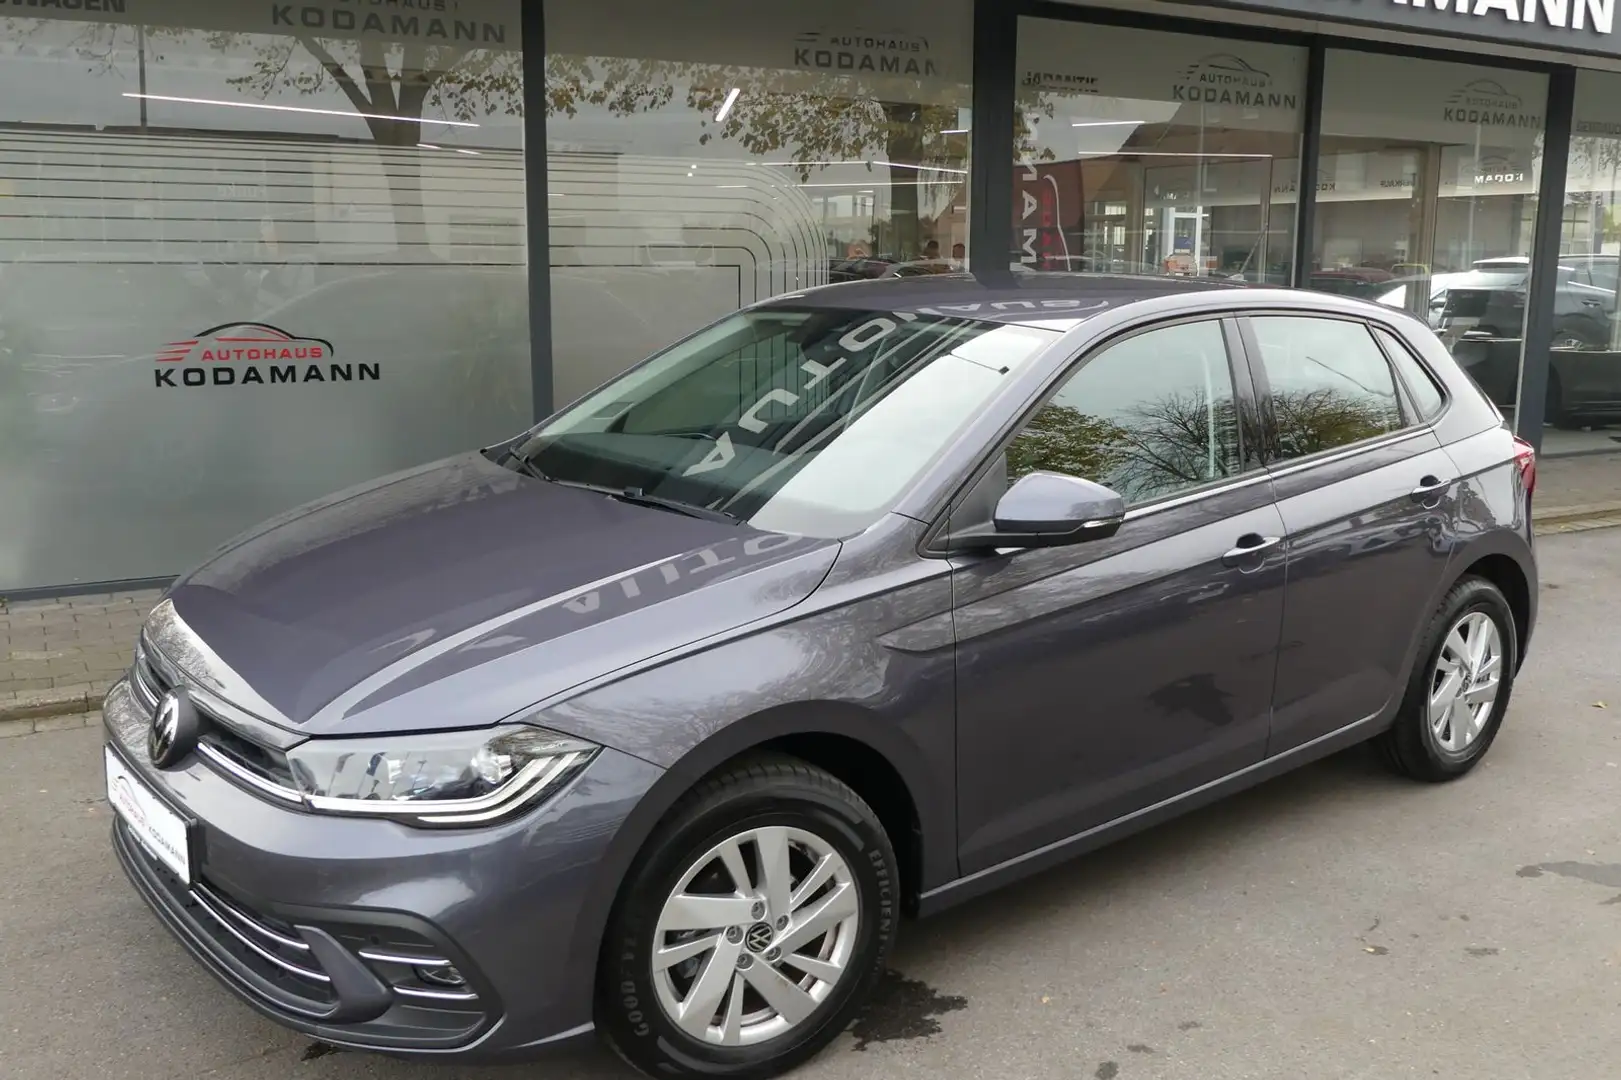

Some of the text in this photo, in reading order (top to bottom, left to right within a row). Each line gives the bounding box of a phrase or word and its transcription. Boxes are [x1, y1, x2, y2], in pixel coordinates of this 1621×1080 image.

[272, 3, 505, 43] KODAMANN
[829, 35, 921, 52] AUTOHAUS
[794, 47, 943, 77] KODAMAN
[1172, 84, 1297, 109] KODAMANN
[1444, 107, 1542, 129] KODAMANN
[201, 347, 324, 362] AUTOHAUS
[154, 363, 381, 388] KODAMANN
